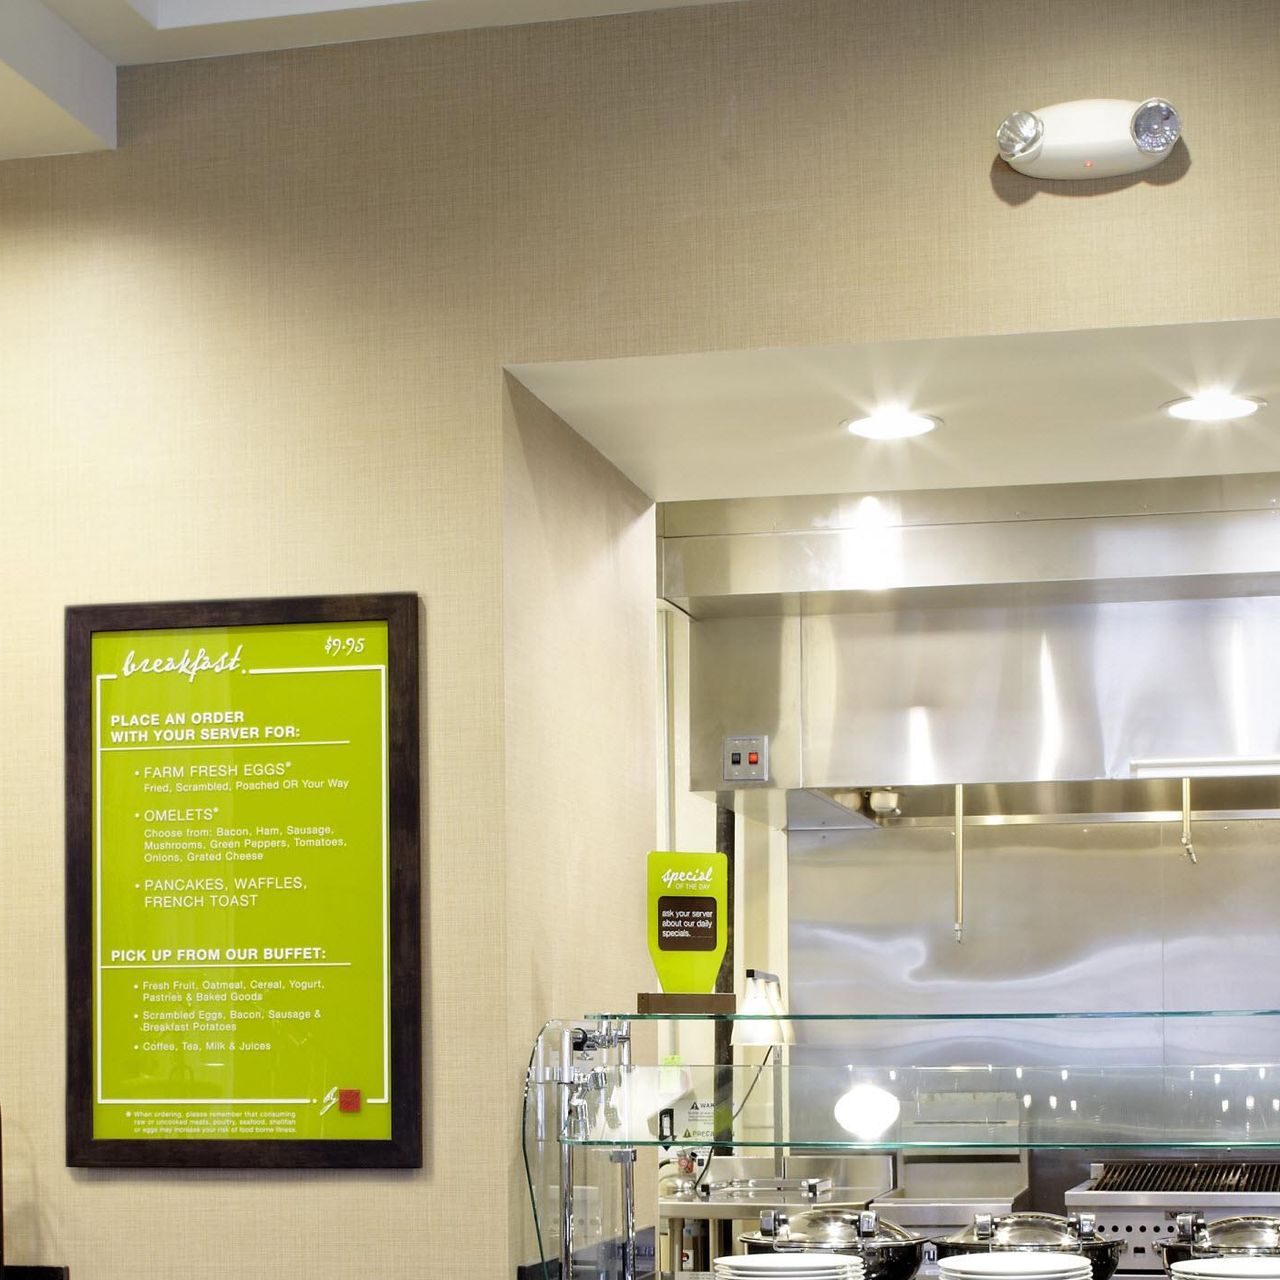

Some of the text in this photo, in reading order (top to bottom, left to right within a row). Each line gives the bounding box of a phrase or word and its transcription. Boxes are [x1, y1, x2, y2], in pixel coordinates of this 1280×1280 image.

[325, 636, 365, 656] $9.95
[111, 711, 244, 728] PLACE AN ORDER
[111, 726, 300, 743] WITH YOUR SERVER FOR:
[144, 766, 184, 778] FARM
[190, 764, 238, 777] FRESH
[236, 780, 280, 790] Poached
[283, 780, 298, 789] OR
[302, 779, 324, 788] Your
[327, 779, 349, 789] Way
[144, 829, 182, 838] Choose
[186, 828, 212, 837] from:
[210, 840, 240, 848] Green
[187, 852, 221, 861] Grated
[225, 852, 264, 861] Cheese
[662, 867, 713, 888] special
[144, 894, 258, 908] FRENCH TOAST
[662, 909, 674, 917] ask
[662, 919, 682, 927] about
[697, 920, 712, 928] daily
[111, 947, 326, 962] PICK UP FROM OUR BUFFET:
[143, 981, 170, 990] Fresh
[143, 992, 263, 1001] Pastries & Baked Goods
[143, 1011, 195, 1019] Scrambled
[268, 1009, 311, 1020] Sausage
[314, 1010, 321, 1018] &
[143, 1022, 237, 1031] Breakfast Potatoes
[206, 1042, 225, 1050] Milk
[229, 1042, 235, 1050] &
[239, 1041, 271, 1050] Juices
